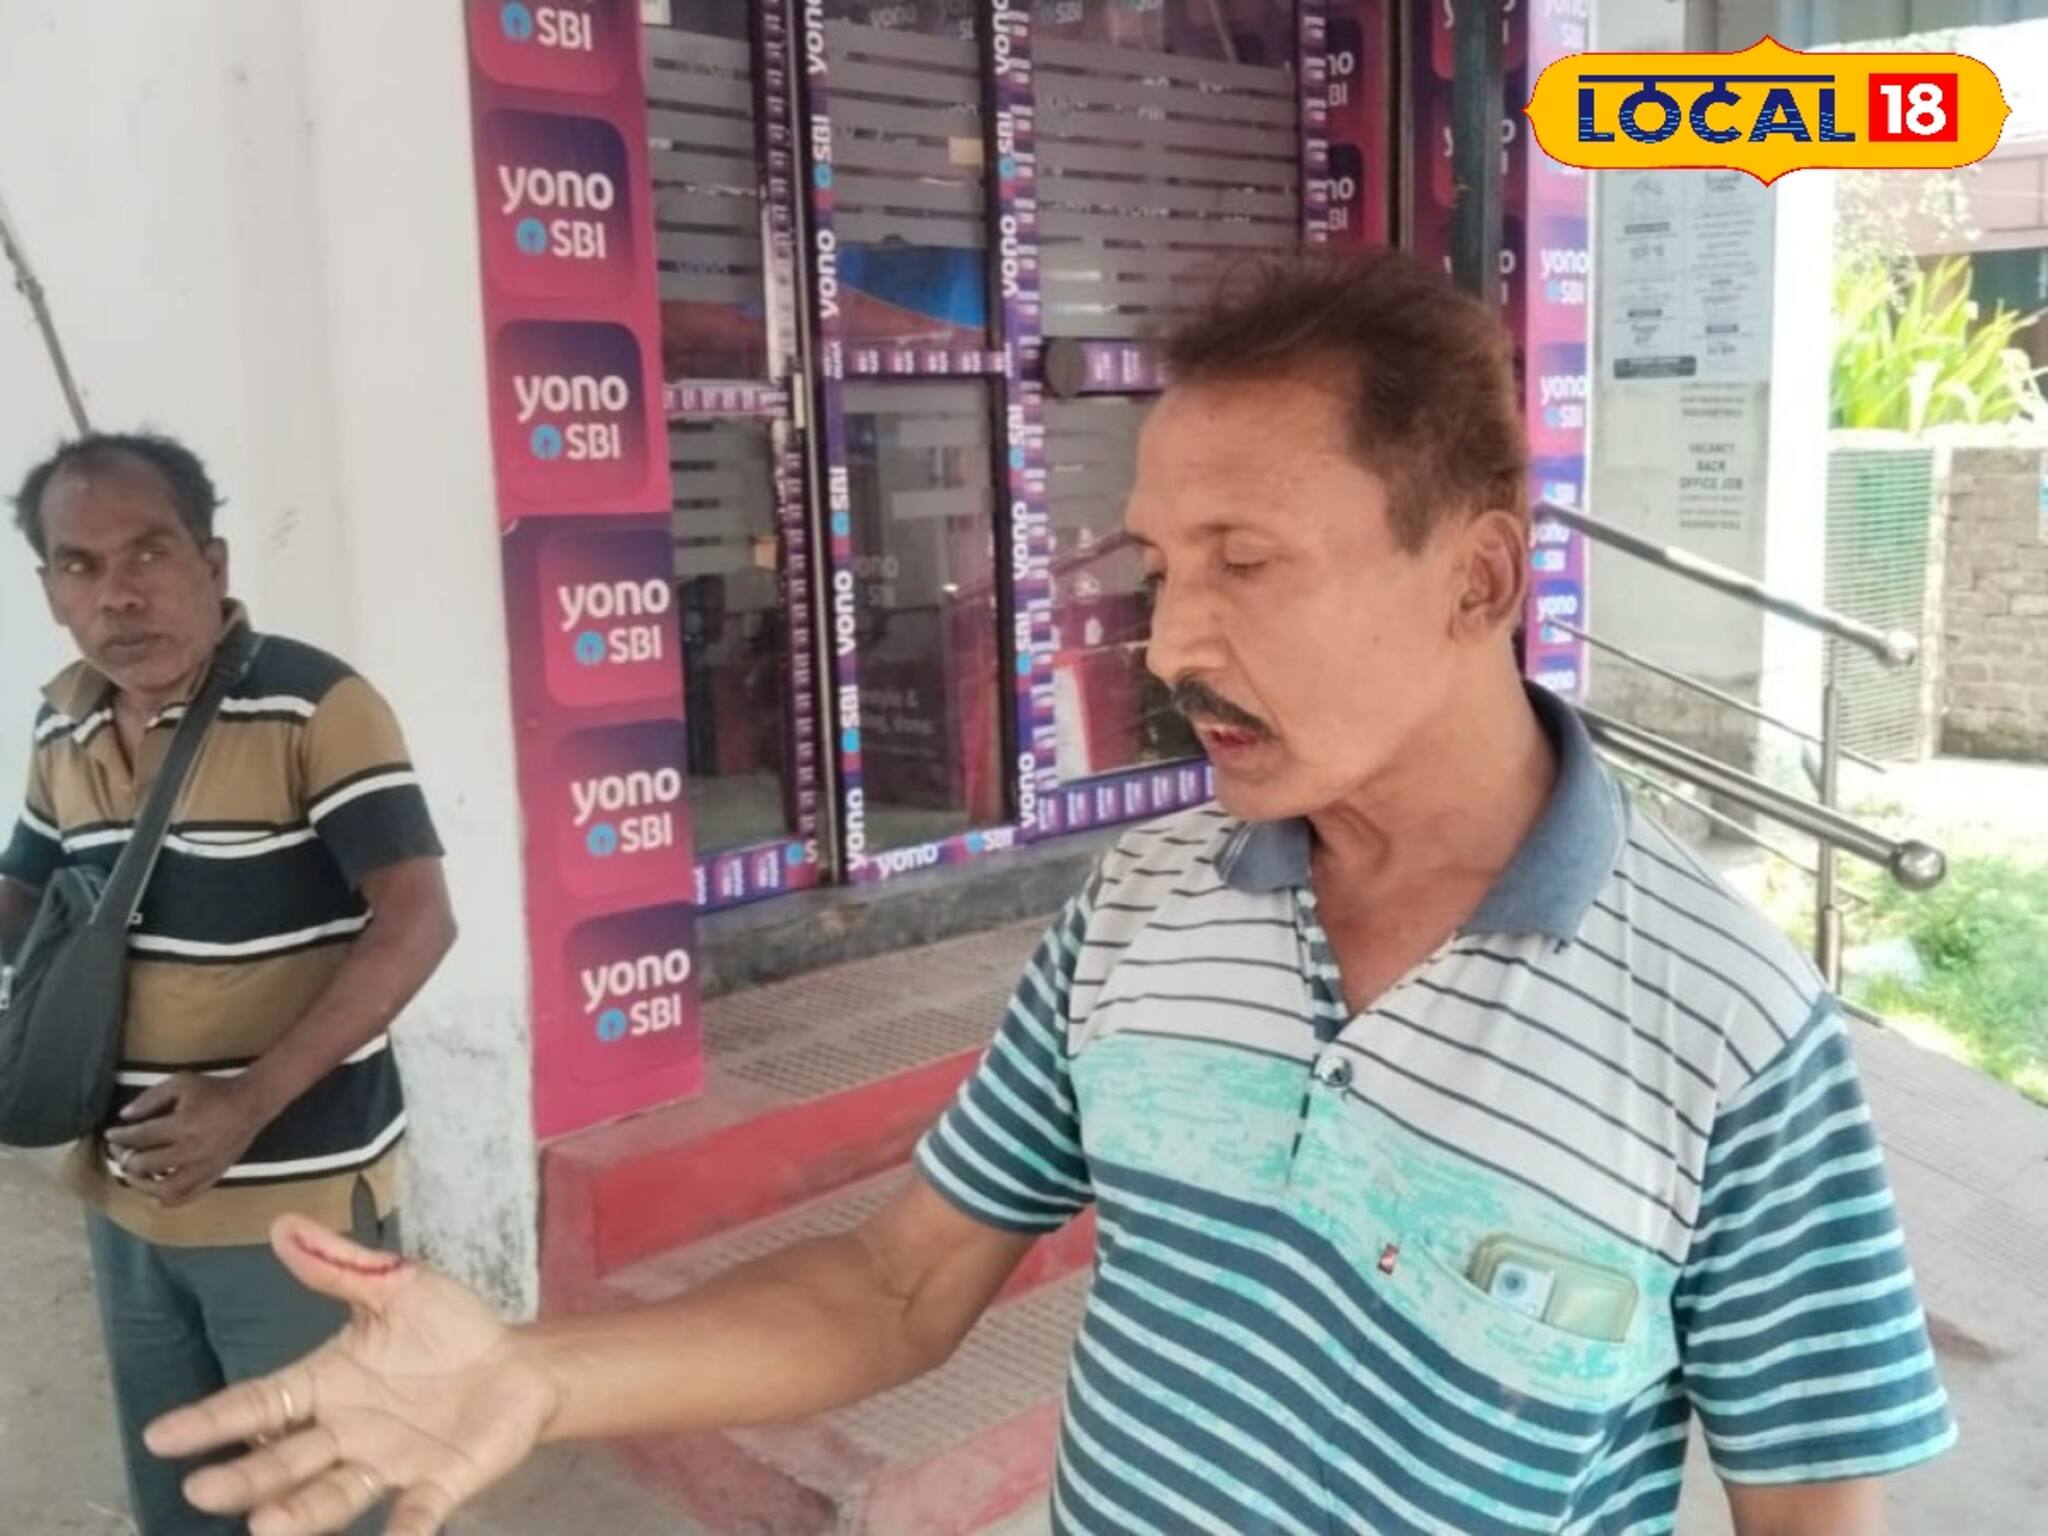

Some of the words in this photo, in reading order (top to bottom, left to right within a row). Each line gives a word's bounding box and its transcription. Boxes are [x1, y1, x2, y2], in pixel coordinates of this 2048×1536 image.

[536, 8, 593, 51] SBI
[811, 115, 832, 162] SBI
[498, 165, 614, 214] yono
[549, 219, 607, 260] SBI
[1000, 216, 1018, 298] yono
[816, 229, 839, 320] yono
[1540, 250, 1588, 281] yono
[1560, 280, 1583, 306] SBI
[513, 374, 629, 424] yono
[1540, 374, 1588, 402] yono
[566, 422, 621, 461] SBI
[1697, 460, 1726, 472] BACK
[1012, 501, 1028, 581] yono
[557, 579, 669, 631] yono
[833, 569, 856, 657] yono
[608, 626, 662, 664] SBI
[838, 685, 861, 728] SBI
[571, 767, 681, 826] yono
[1018, 753, 1036, 829] yono
[619, 813, 673, 853] SBI
[846, 787, 868, 871] yono
[876, 843, 938, 881] yono
[581, 949, 691, 1014] yono
[629, 994, 682, 1037] SBI
